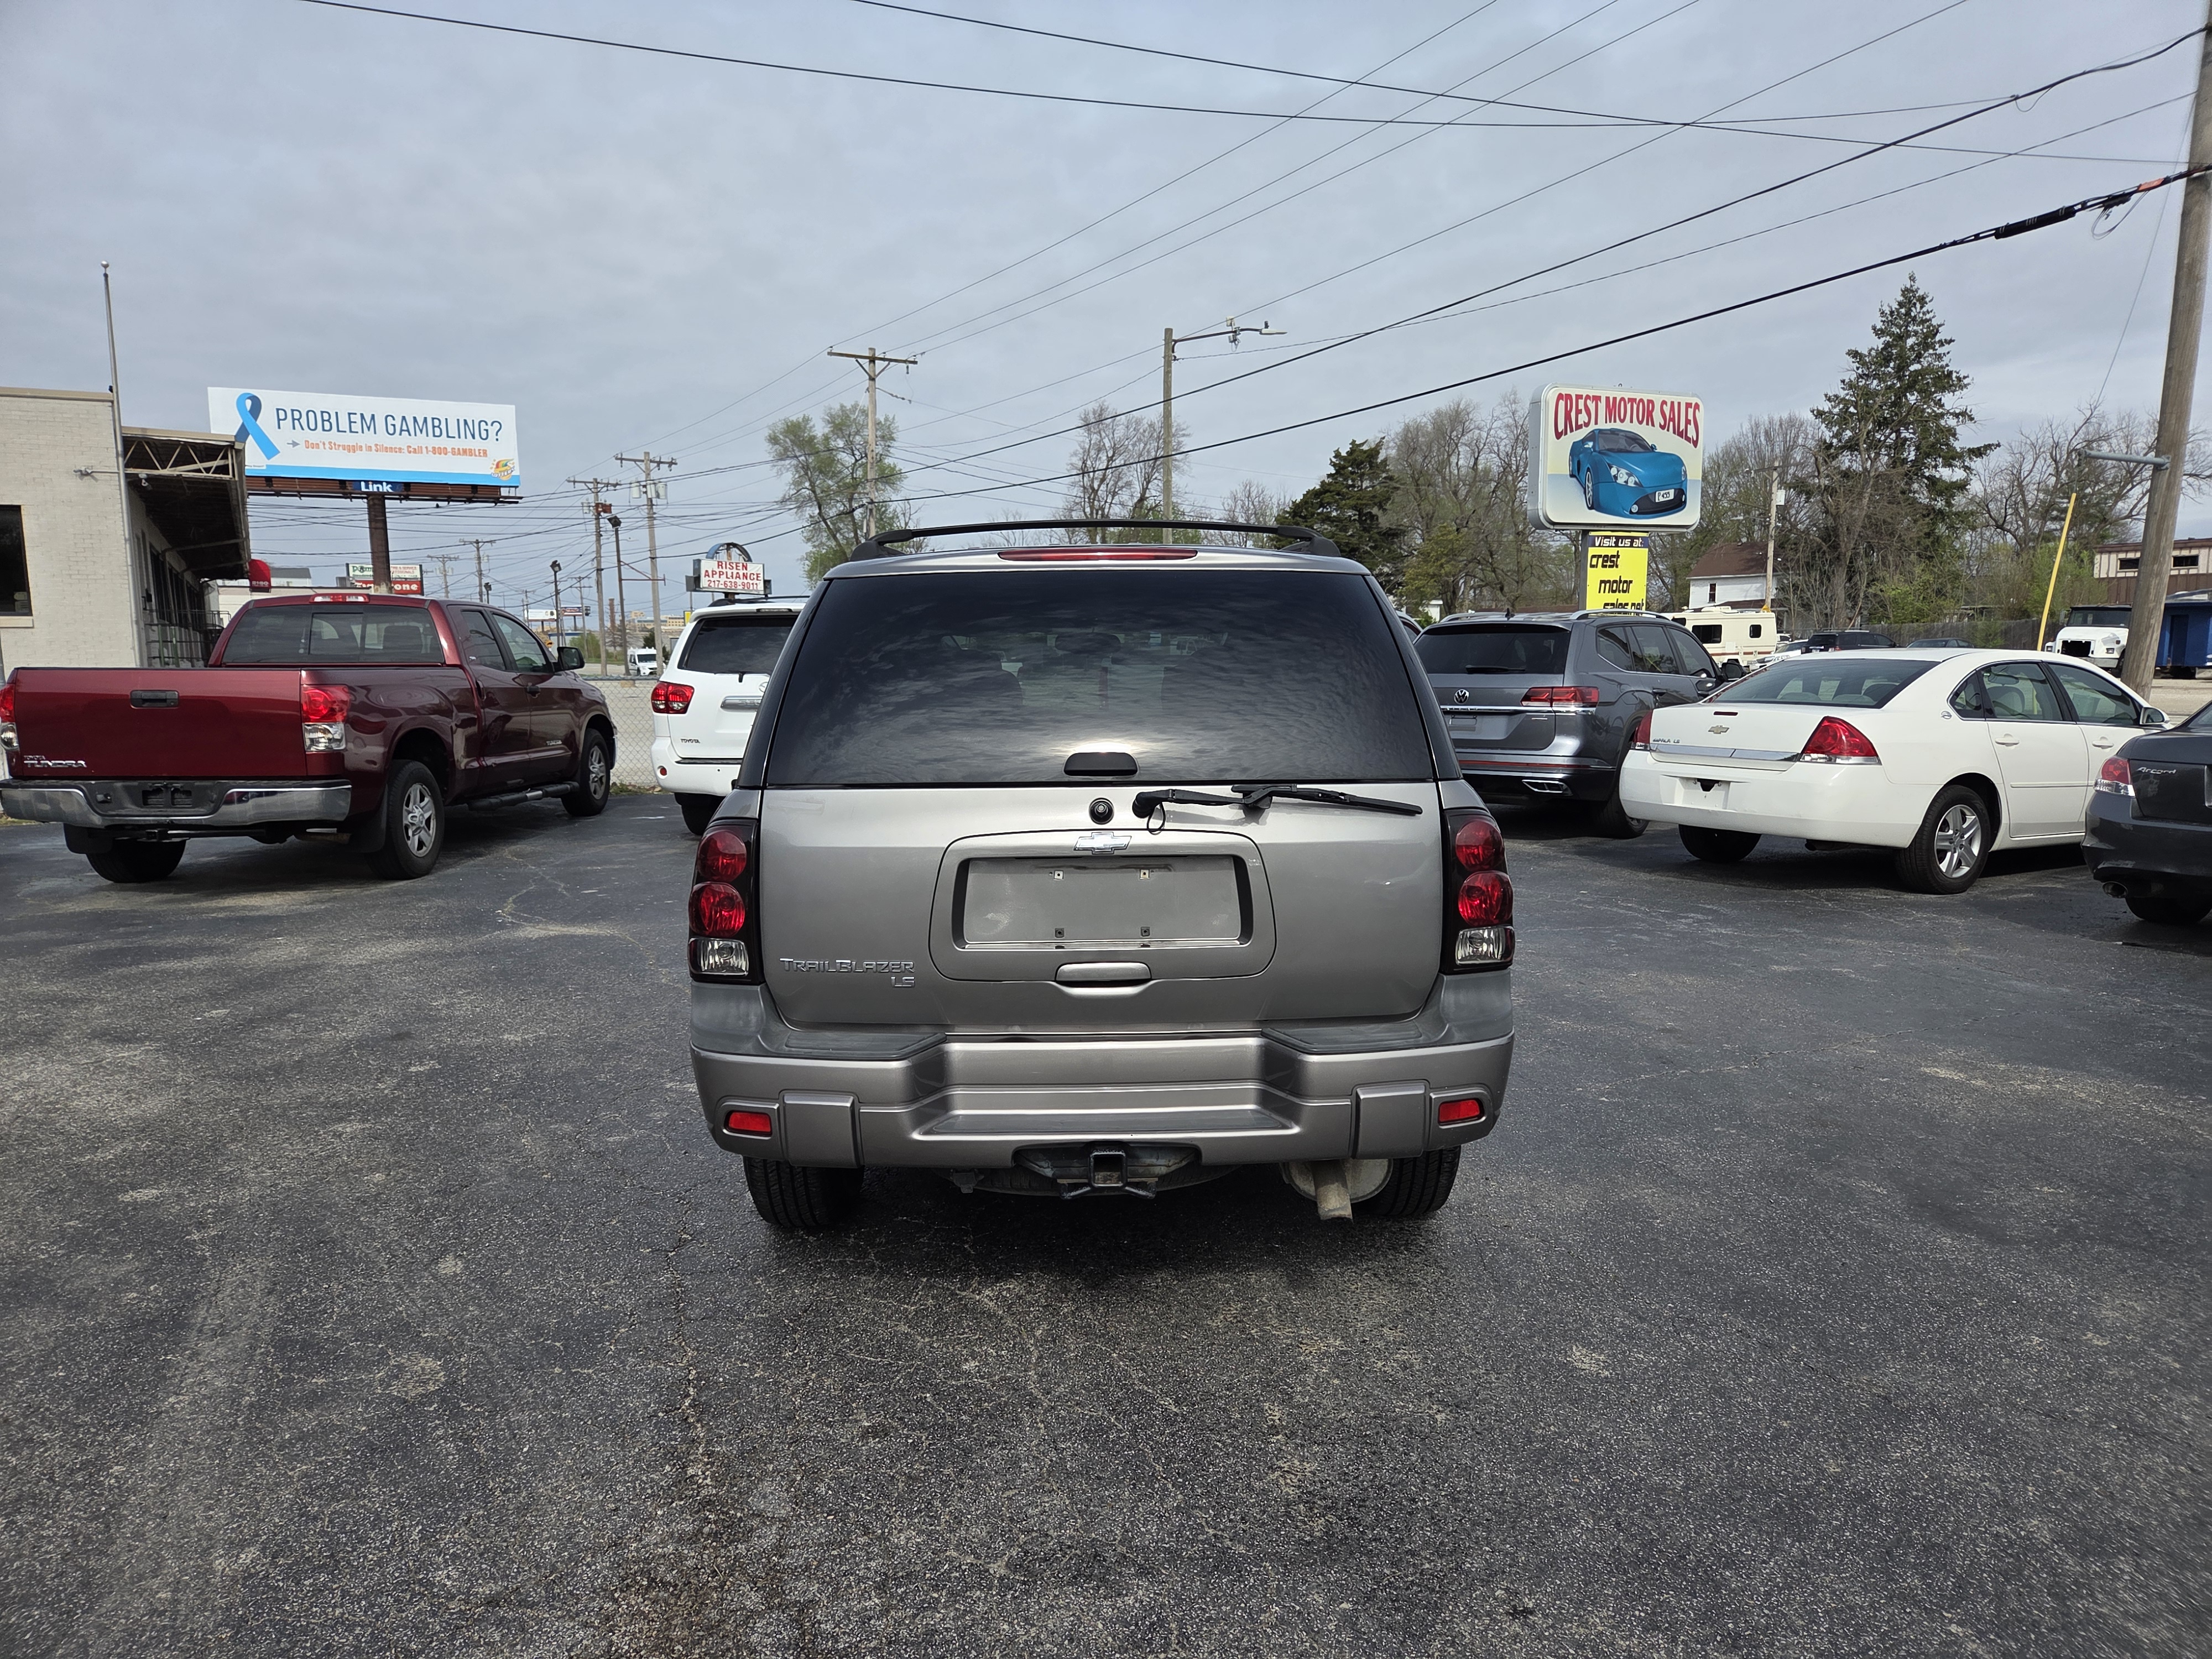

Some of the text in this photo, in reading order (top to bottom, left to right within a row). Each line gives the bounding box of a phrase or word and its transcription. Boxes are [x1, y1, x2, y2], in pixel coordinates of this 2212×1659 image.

[275, 408, 502, 441] PROBLEM GAMBLING?
[1554, 393, 1700, 448] CREST MOTOR SALES
[304, 440, 488, 457] Don't Struggle in Silence: Call 1-800-GAMBLER
[361, 481, 393, 492] Link
[1595, 536, 1616, 546] Visit
[1633, 538, 1644, 547] at:
[1589, 550, 1620, 568] crest
[717, 560, 748, 571] RISEN
[704, 570, 761, 581] APPLIANCE
[707, 580, 758, 590] 217-638-9011
[1598, 576, 1633, 593] motor
[890, 976, 915, 988] LS
